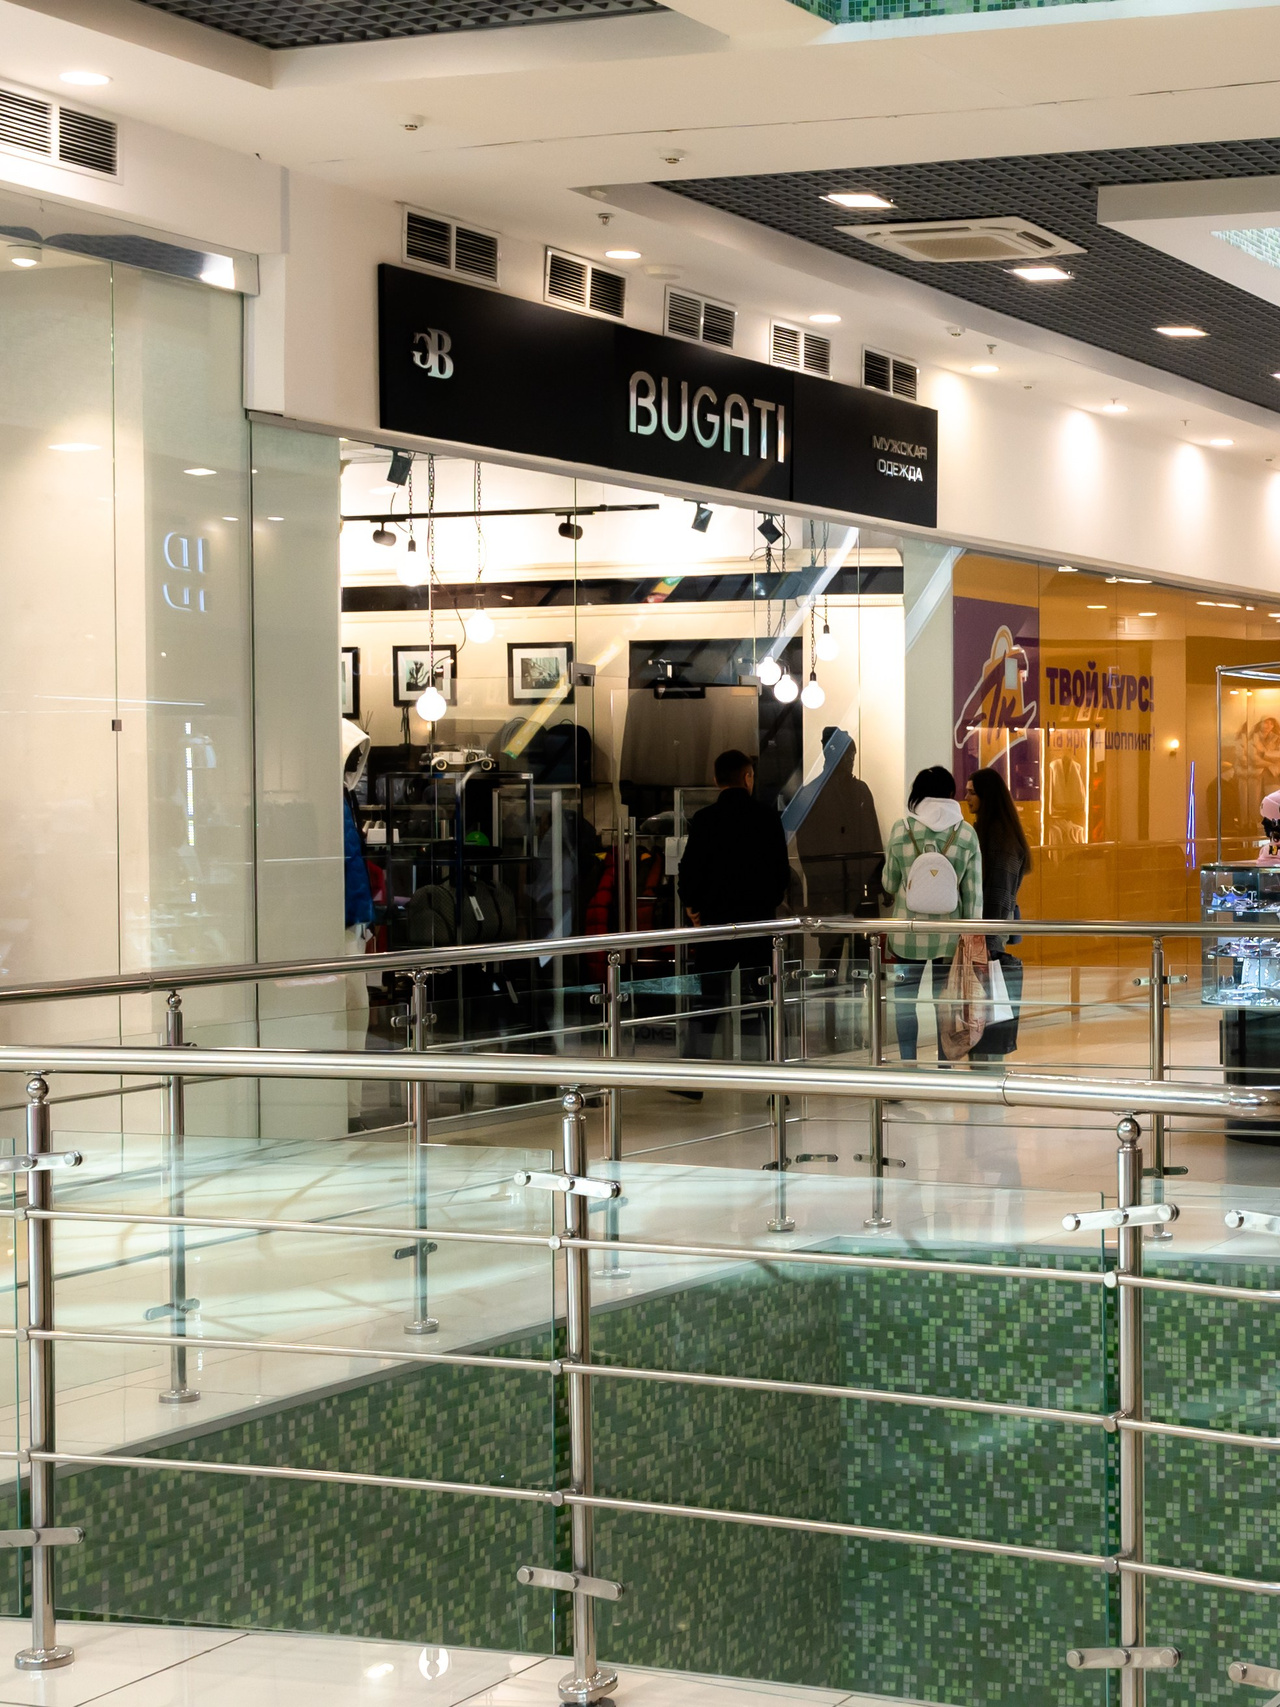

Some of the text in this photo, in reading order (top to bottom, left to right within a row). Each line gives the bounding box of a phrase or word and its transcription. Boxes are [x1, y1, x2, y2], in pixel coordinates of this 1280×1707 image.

[629, 370, 785, 463] BUGATI
[872, 435, 928, 460] МУЖСКАЯ
[877, 459, 923, 482] ОДЕЖДА
[1045, 660, 1099, 709] ТВОЙ
[1102, 672, 1155, 712] КУРС!
